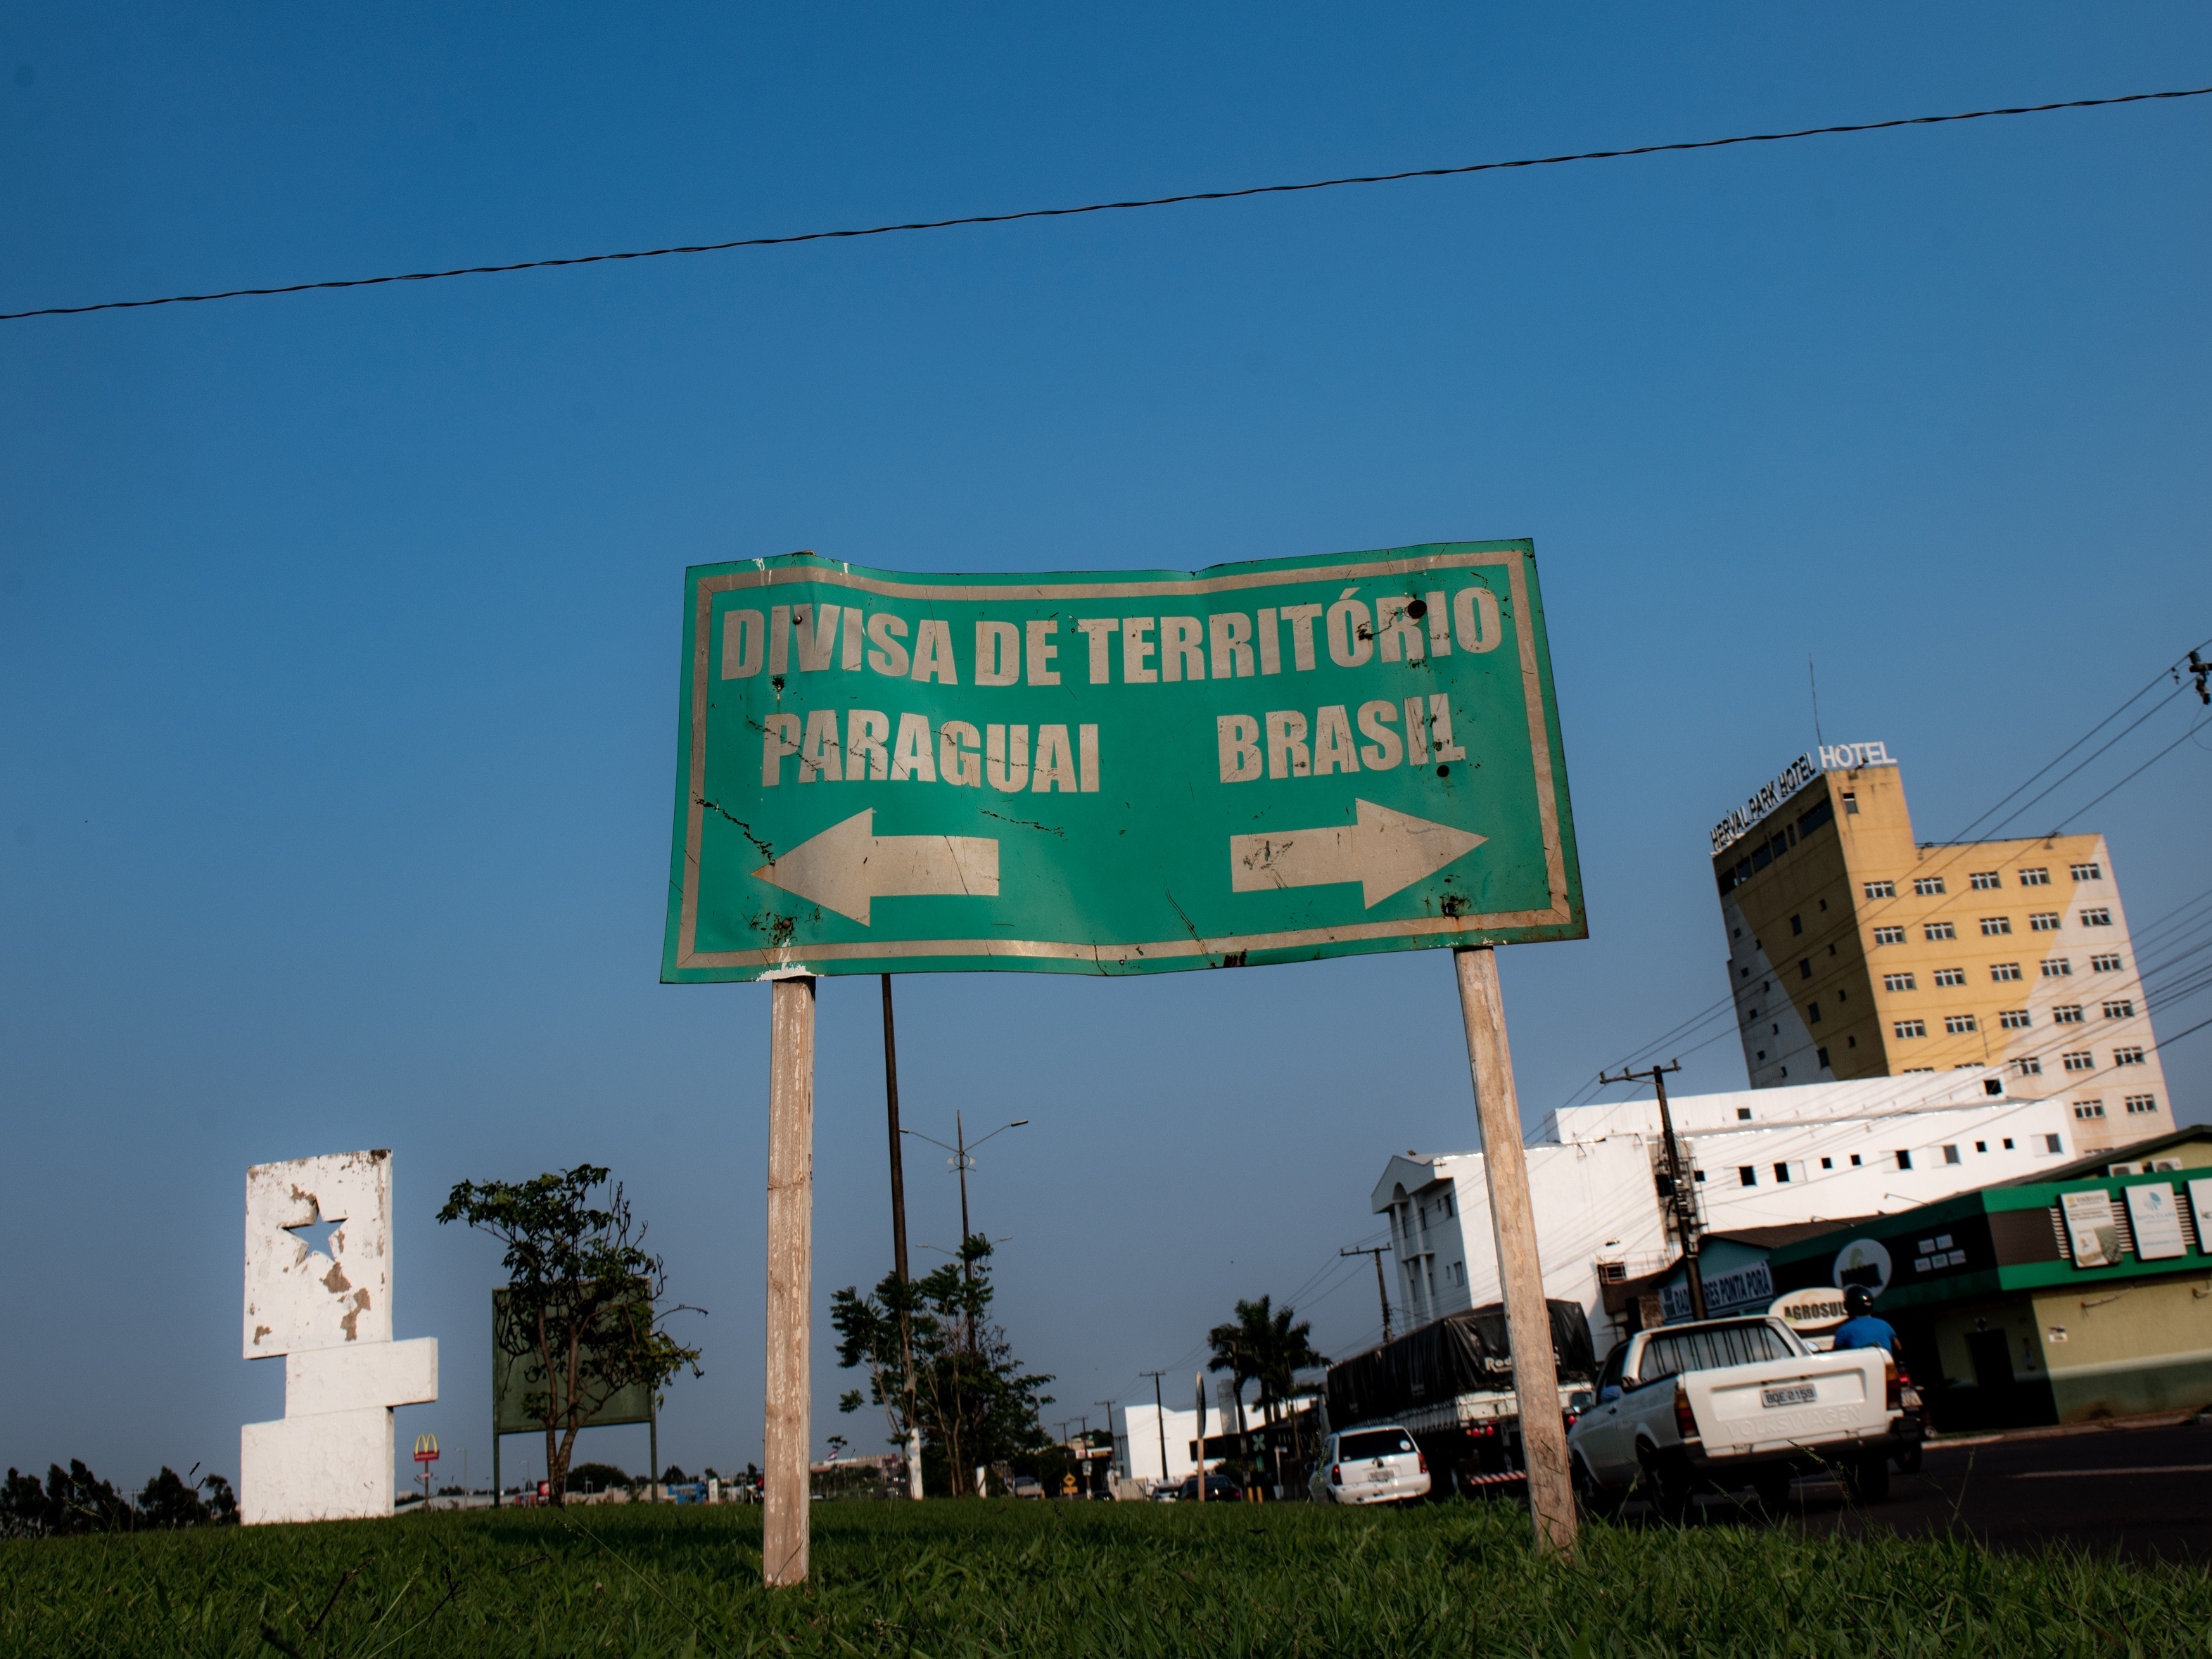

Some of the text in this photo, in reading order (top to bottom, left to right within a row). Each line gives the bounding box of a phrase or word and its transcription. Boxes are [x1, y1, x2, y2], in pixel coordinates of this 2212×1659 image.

[721, 587, 1502, 687] DIVISA DE TERRITÓRIO
[761, 709, 1100, 793] PARAGUAI
[1216, 693, 1466, 784] BRASIL
[1819, 742, 1898, 768] HOTEL
[1710, 752, 1816, 851] HERVAL PARK HOTEL
[1719, 1273, 1748, 1302] PONTA
[1784, 1302, 1847, 1321] AGROSUL
